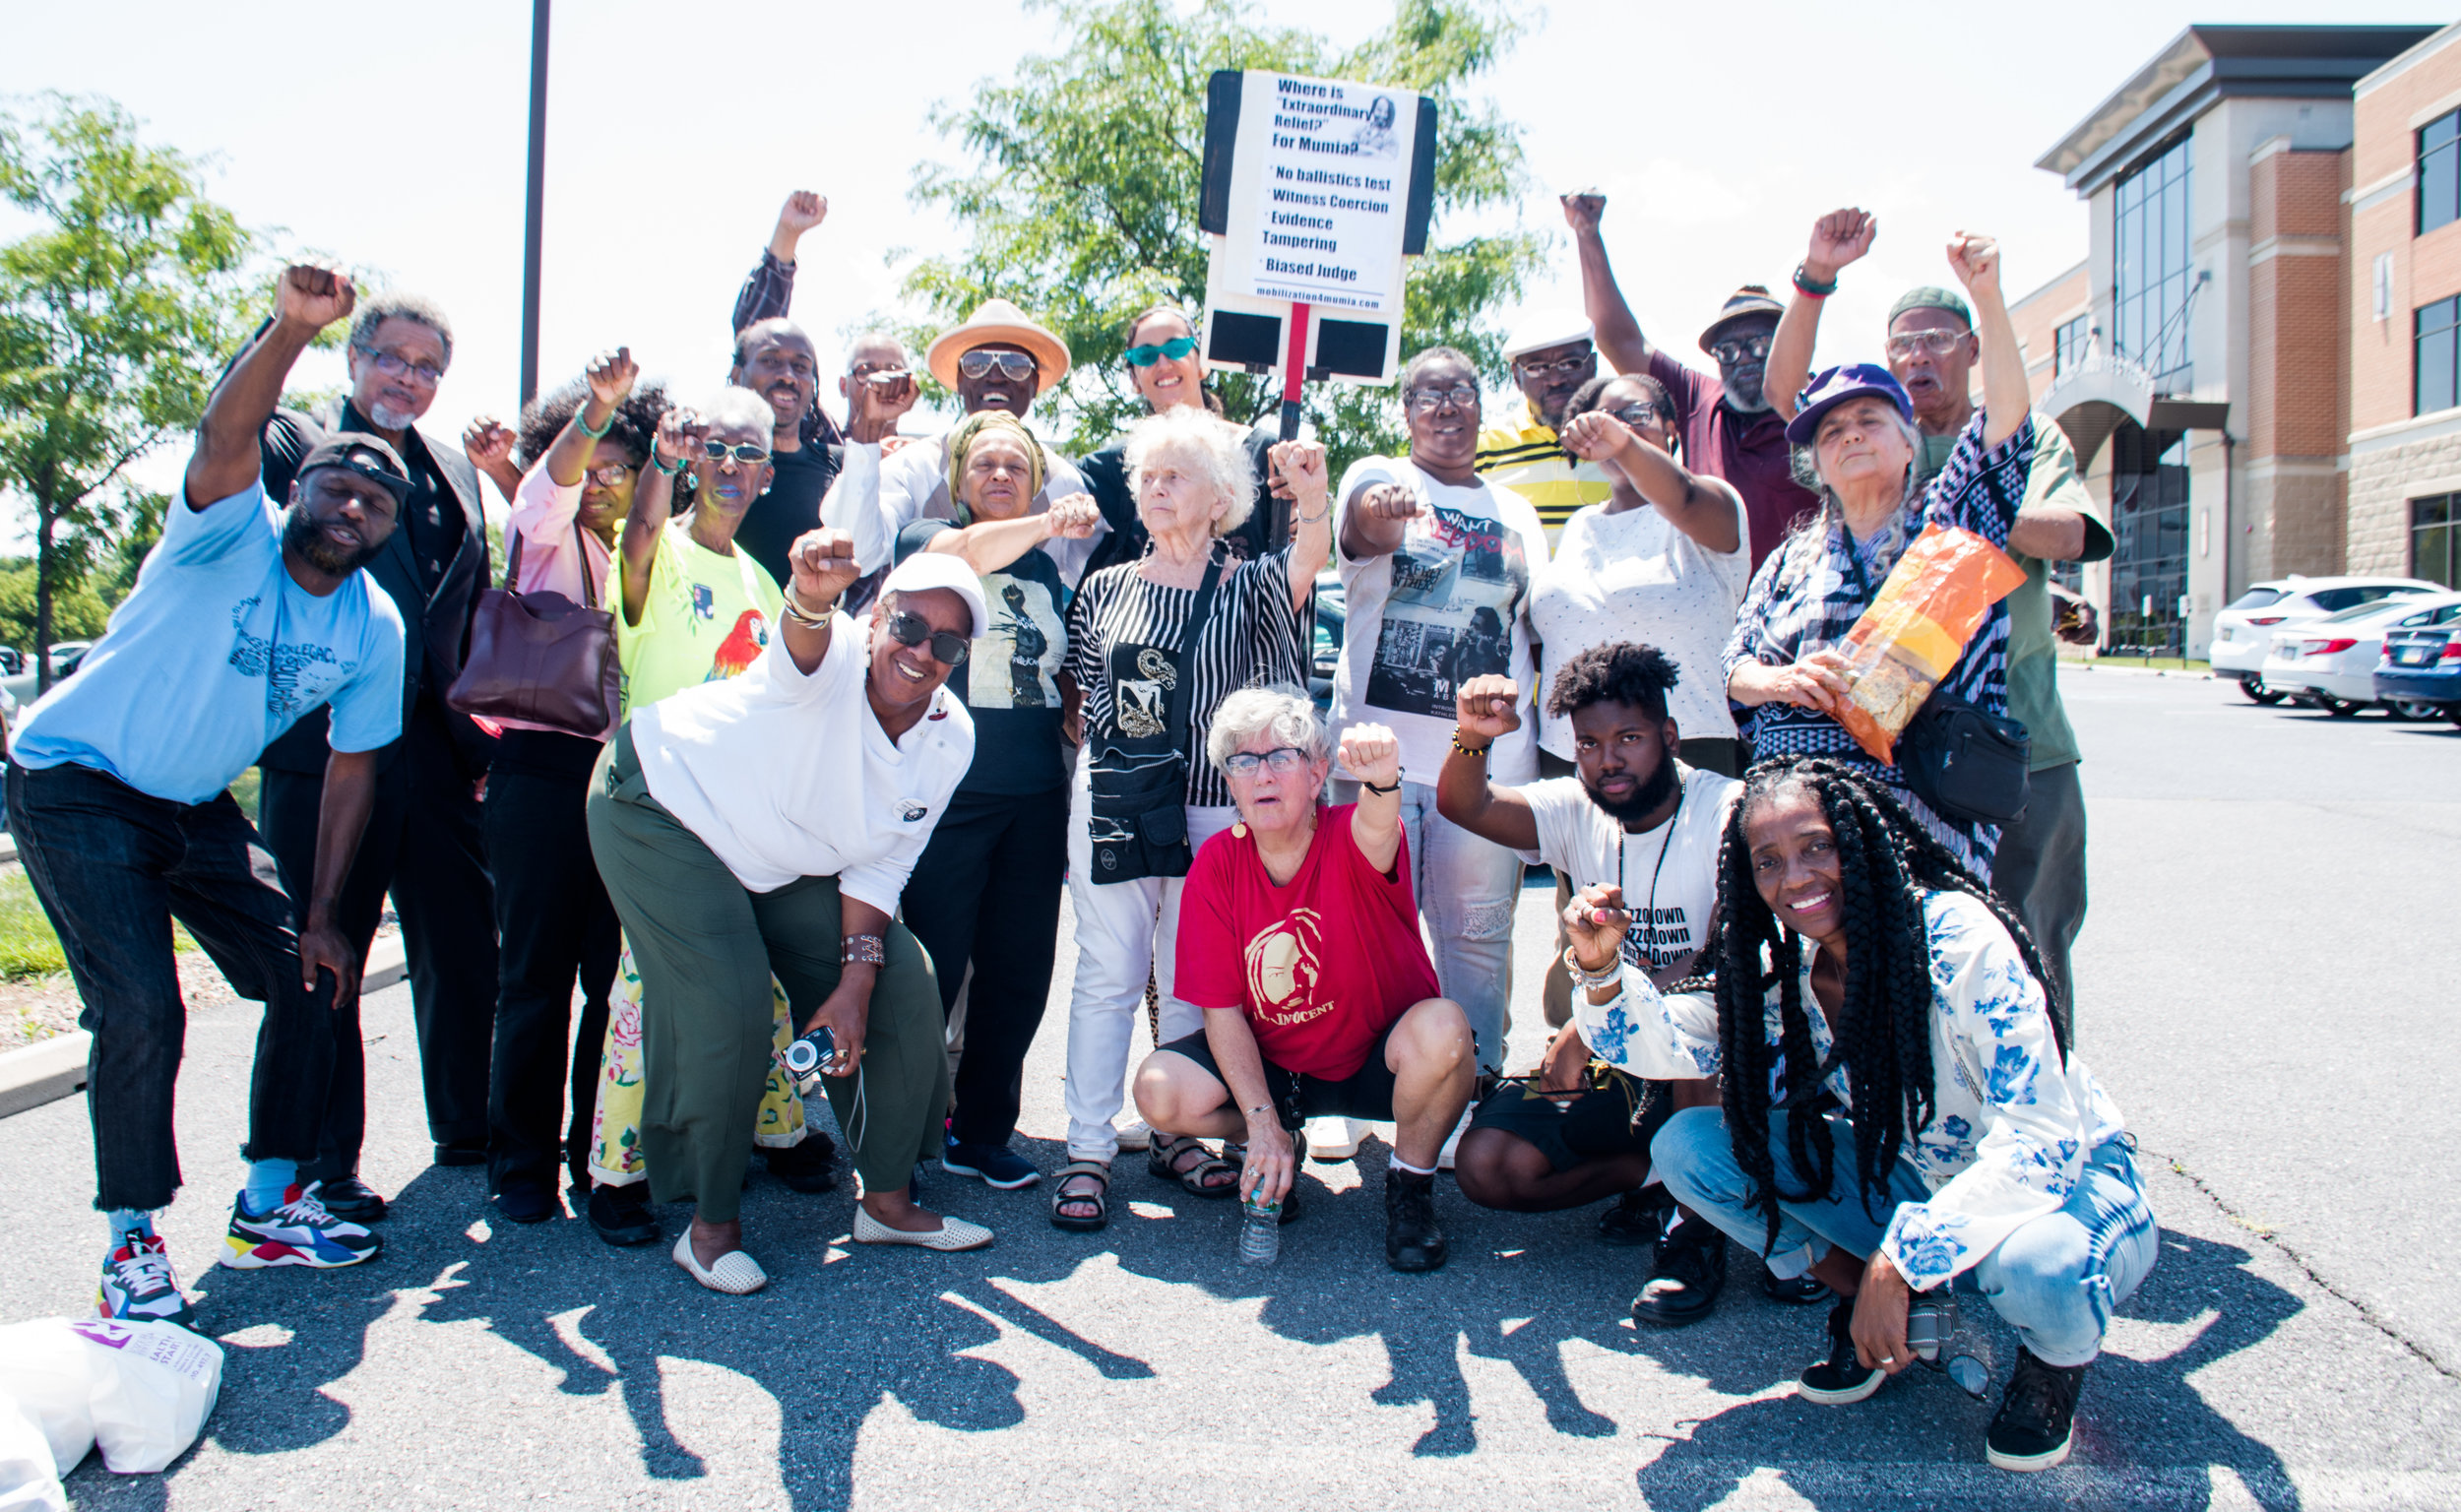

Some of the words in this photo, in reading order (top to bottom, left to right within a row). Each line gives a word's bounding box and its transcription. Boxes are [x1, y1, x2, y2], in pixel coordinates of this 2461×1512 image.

[1278, 79, 1327, 98] Where
[1331, 86, 1344, 99] is
[1274, 114, 1329, 132] Relief?"
[1272, 132, 1295, 150] For
[1298, 137, 1359, 158] Mumia?
[1276, 164, 1294, 181] No
[1295, 167, 1361, 189] ballistics
[1364, 174, 1391, 192] test
[1273, 188, 1327, 208] Witness
[1329, 194, 1389, 215] Coercion
[1270, 210, 1334, 230] Evidence
[1262, 230, 1338, 253] Tampering
[1265, 258, 1314, 277] Biased
[1316, 263, 1357, 283] Judge
[1256, 284, 1380, 310] mobilization4mumia.com
[1441, 510, 1492, 534] WANT
